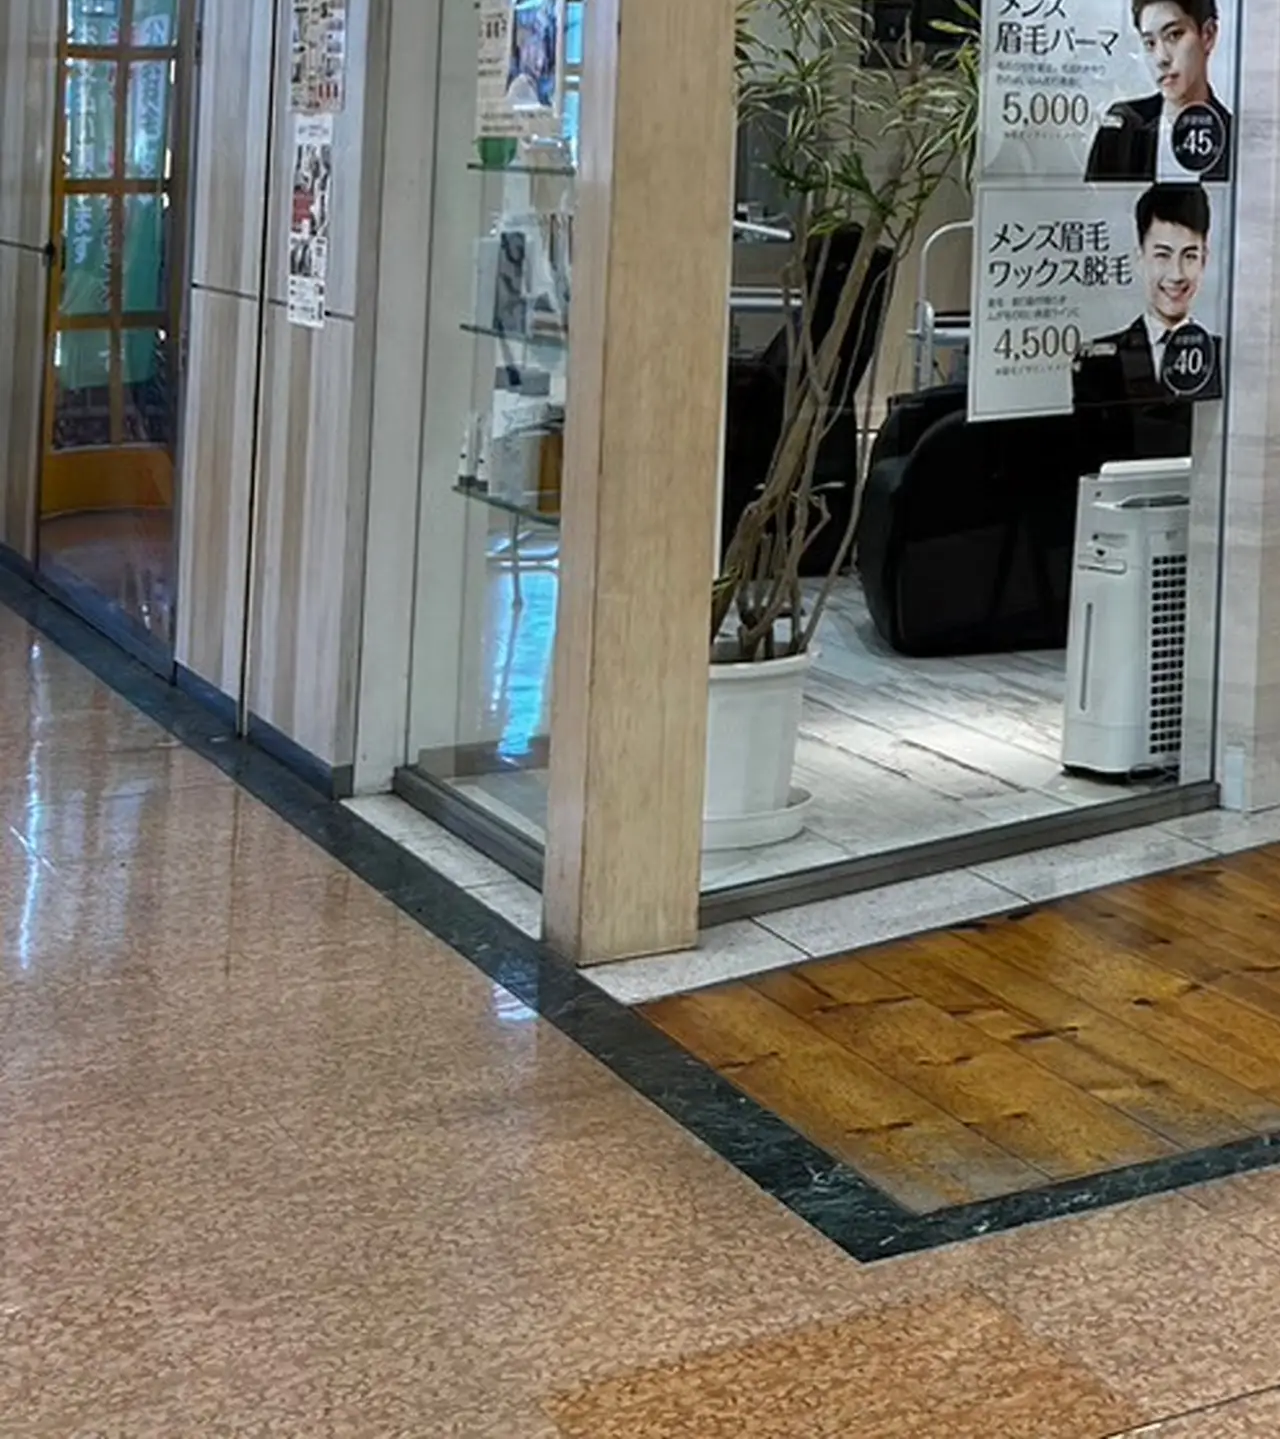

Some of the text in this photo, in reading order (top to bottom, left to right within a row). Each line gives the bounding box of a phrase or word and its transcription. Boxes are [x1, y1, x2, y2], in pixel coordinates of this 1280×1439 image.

[1182, 129, 1213, 155] 45
[988, 221, 1110, 253] メンズ眉毛
[988, 254, 1133, 289] ワックス脱毛
[993, 324, 1081, 361] 4,500
[1174, 349, 1203, 375] 40
